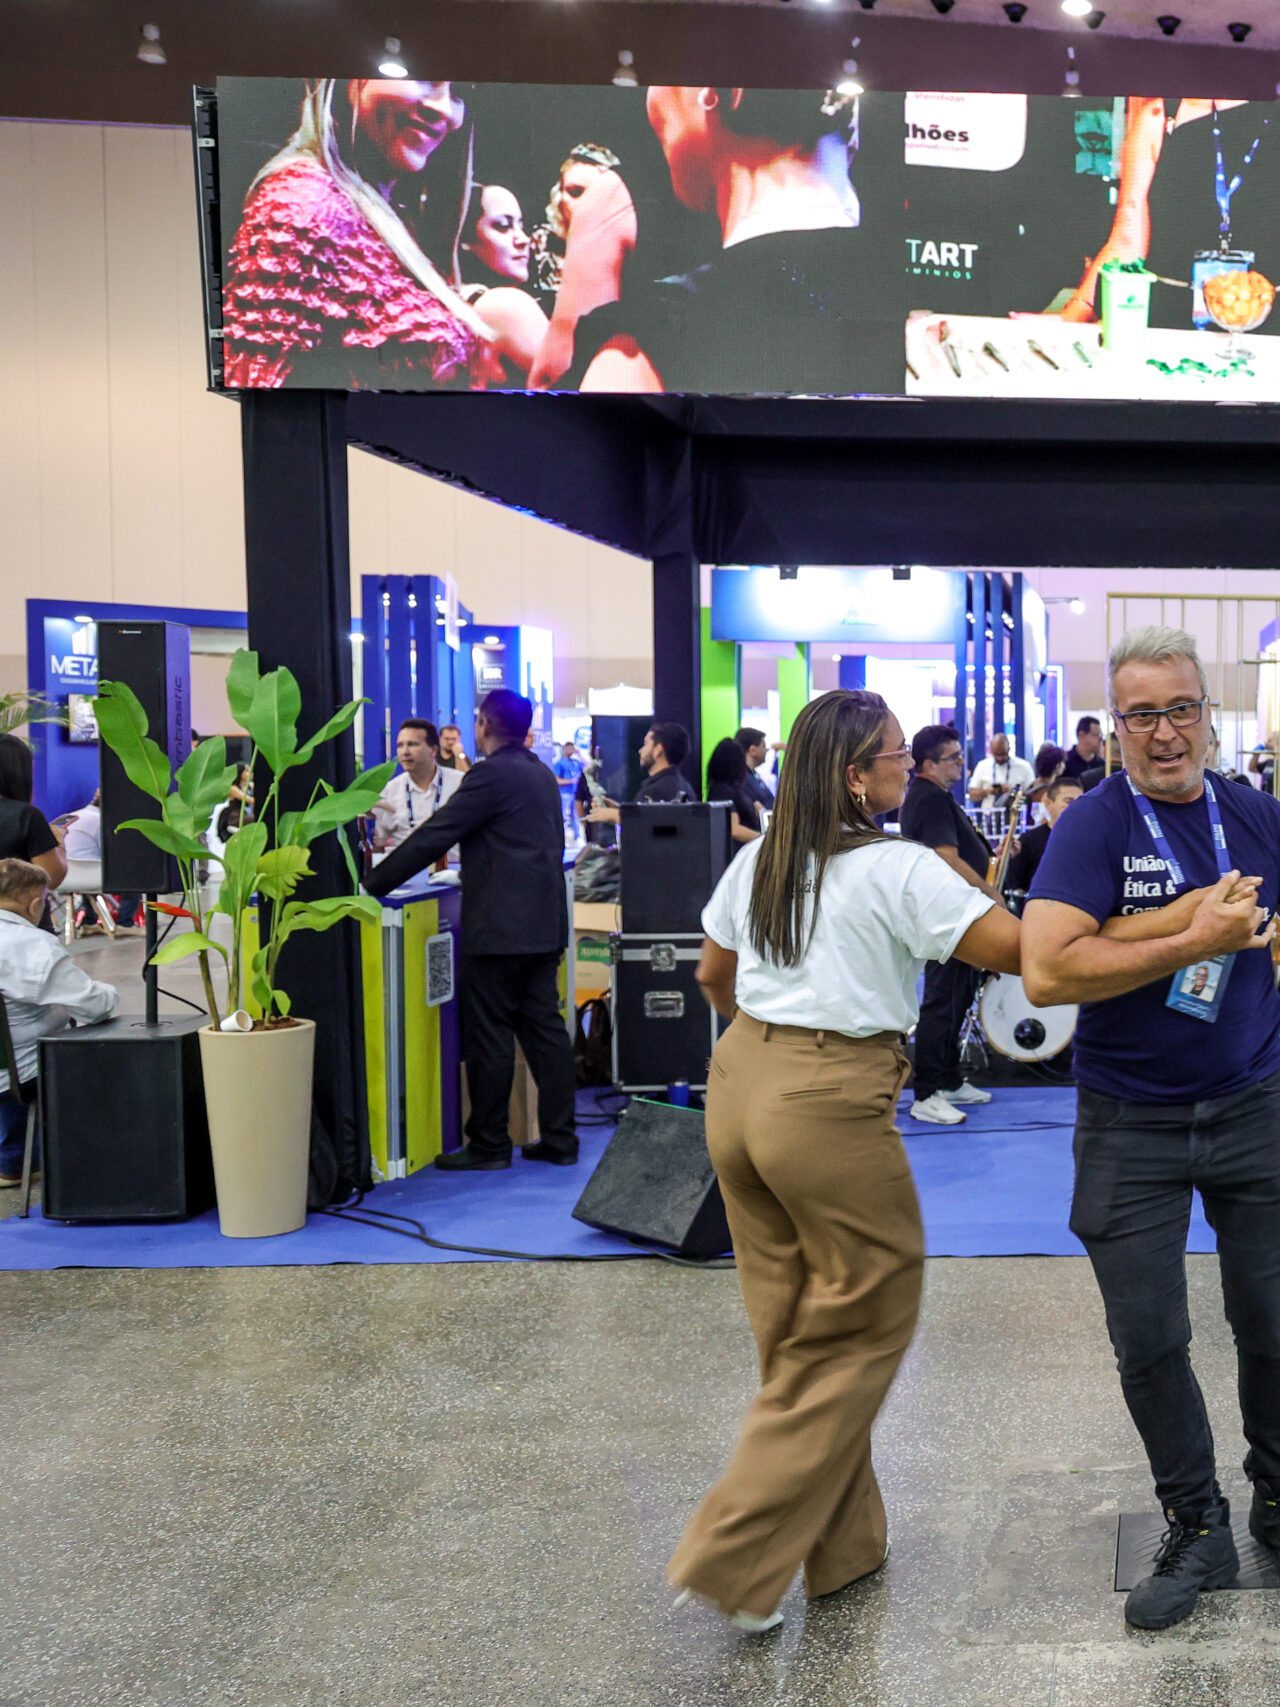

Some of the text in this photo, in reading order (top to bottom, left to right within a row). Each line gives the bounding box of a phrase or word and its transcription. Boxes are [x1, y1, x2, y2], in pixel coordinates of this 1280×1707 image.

[905, 239, 979, 268] TART
[1123, 855, 1167, 873] União
[1123, 876, 1163, 898] Ética
